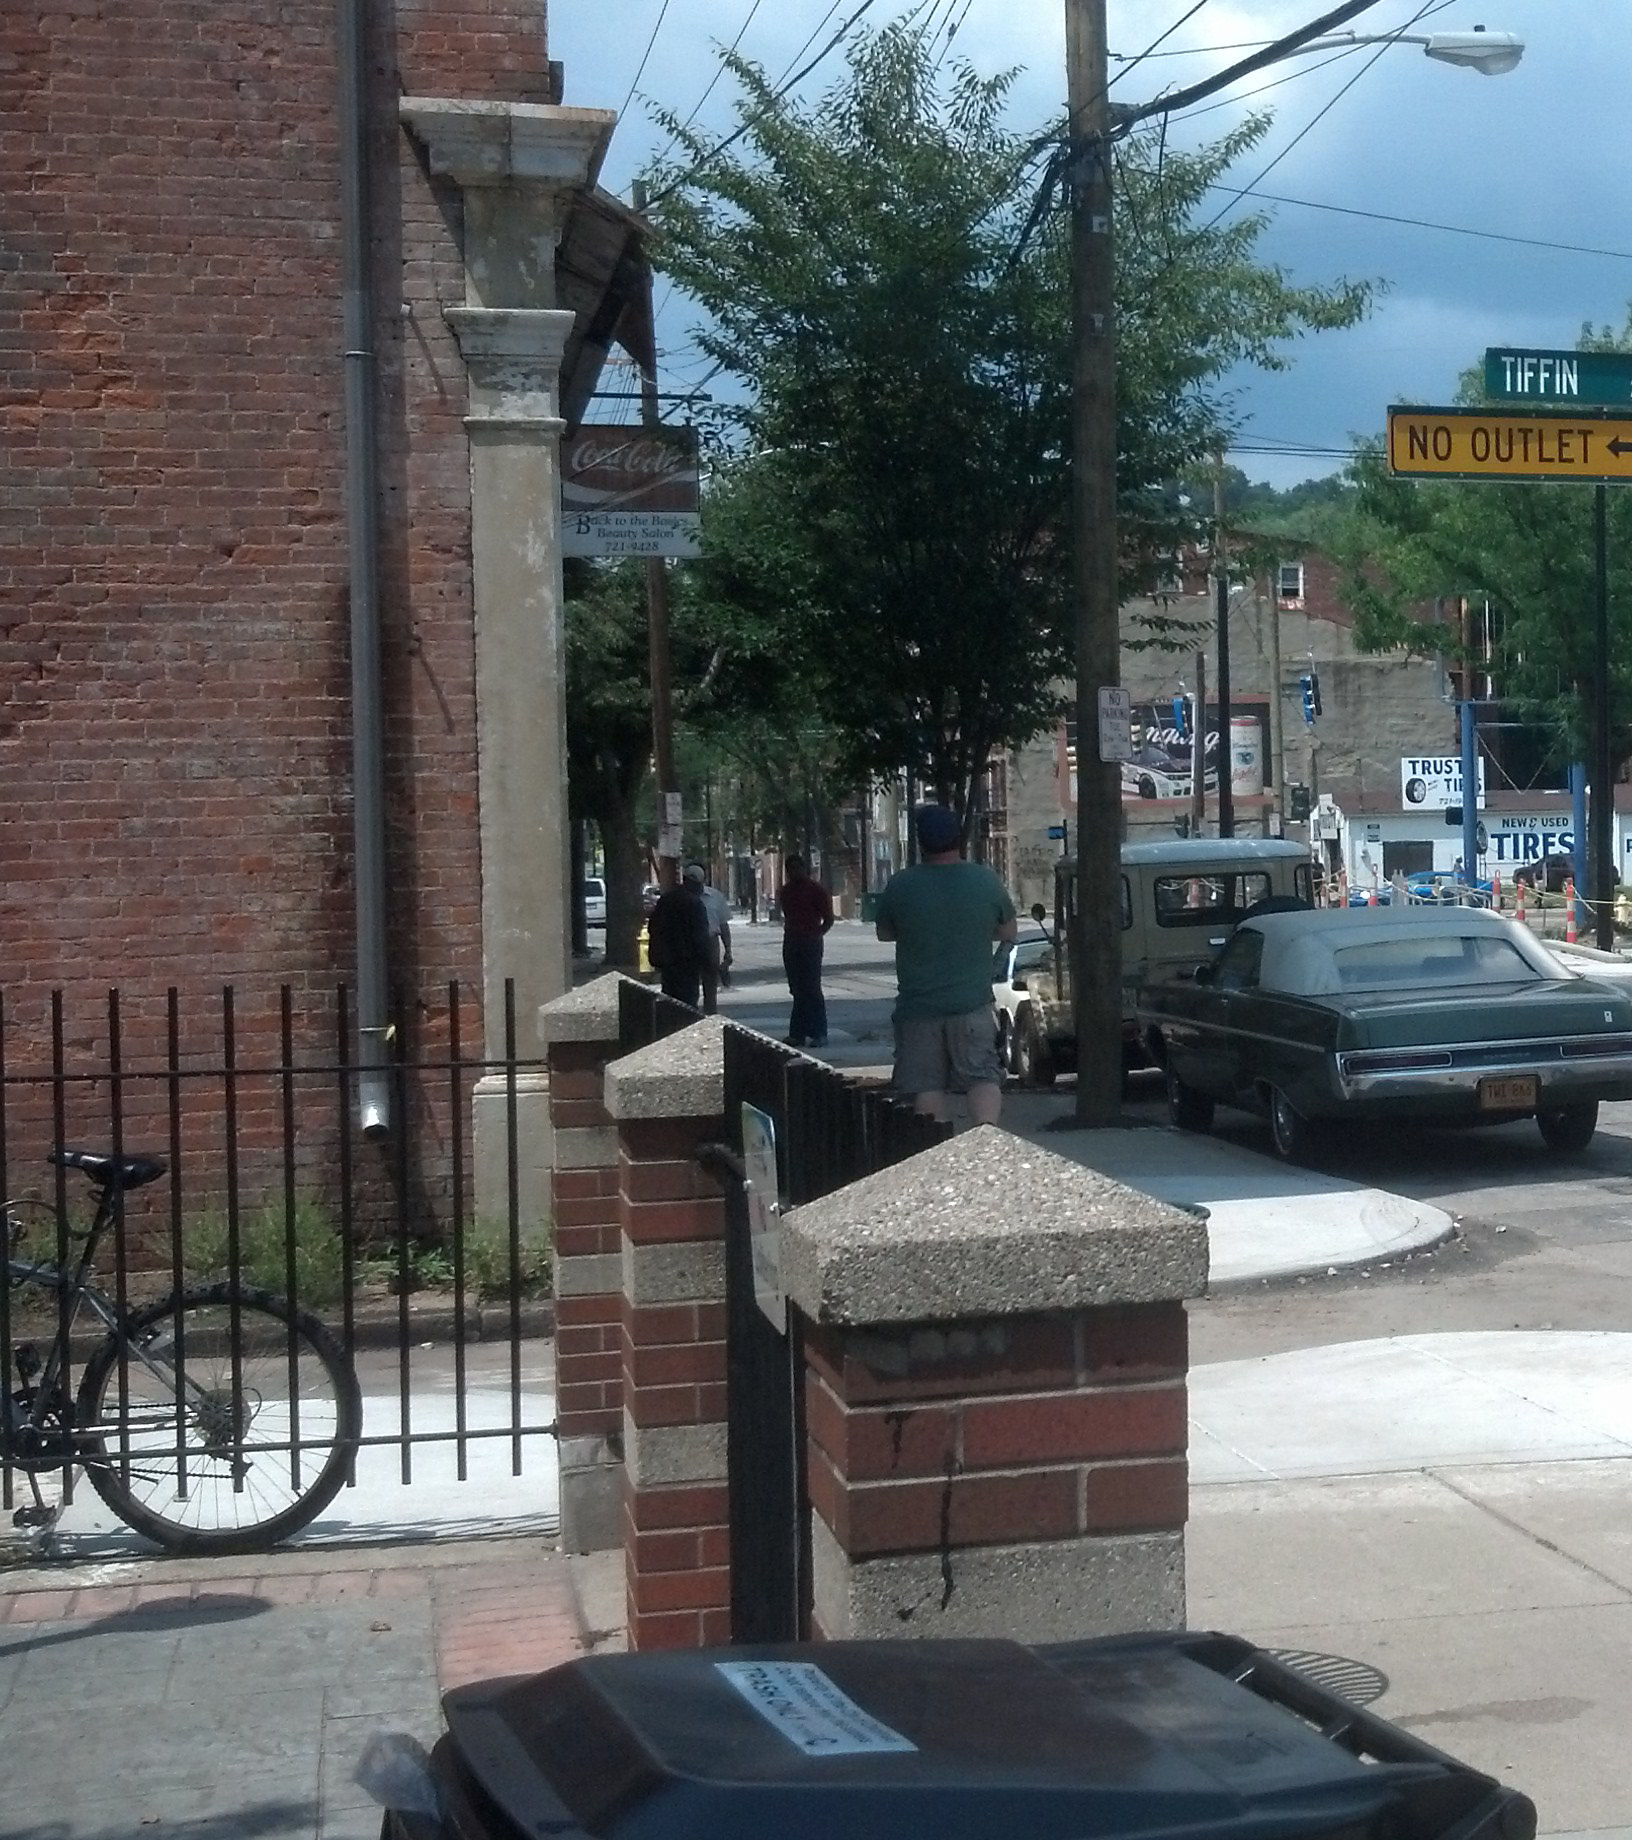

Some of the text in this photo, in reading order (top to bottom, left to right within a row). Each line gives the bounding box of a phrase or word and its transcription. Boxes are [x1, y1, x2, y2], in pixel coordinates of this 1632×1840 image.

[1501, 356, 1579, 395] TIFFIN
[1408, 424, 1594, 464] NO OUTLET
[576, 515, 611, 535] Back
[615, 517, 626, 526] to
[630, 515, 649, 526] the
[597, 527, 676, 539] Beauty Salon
[1109, 693, 1121, 706] NO
[1502, 818, 1527, 829] NEW
[1541, 817, 1569, 828] USED
[1490, 831, 1575, 861] TIRES
